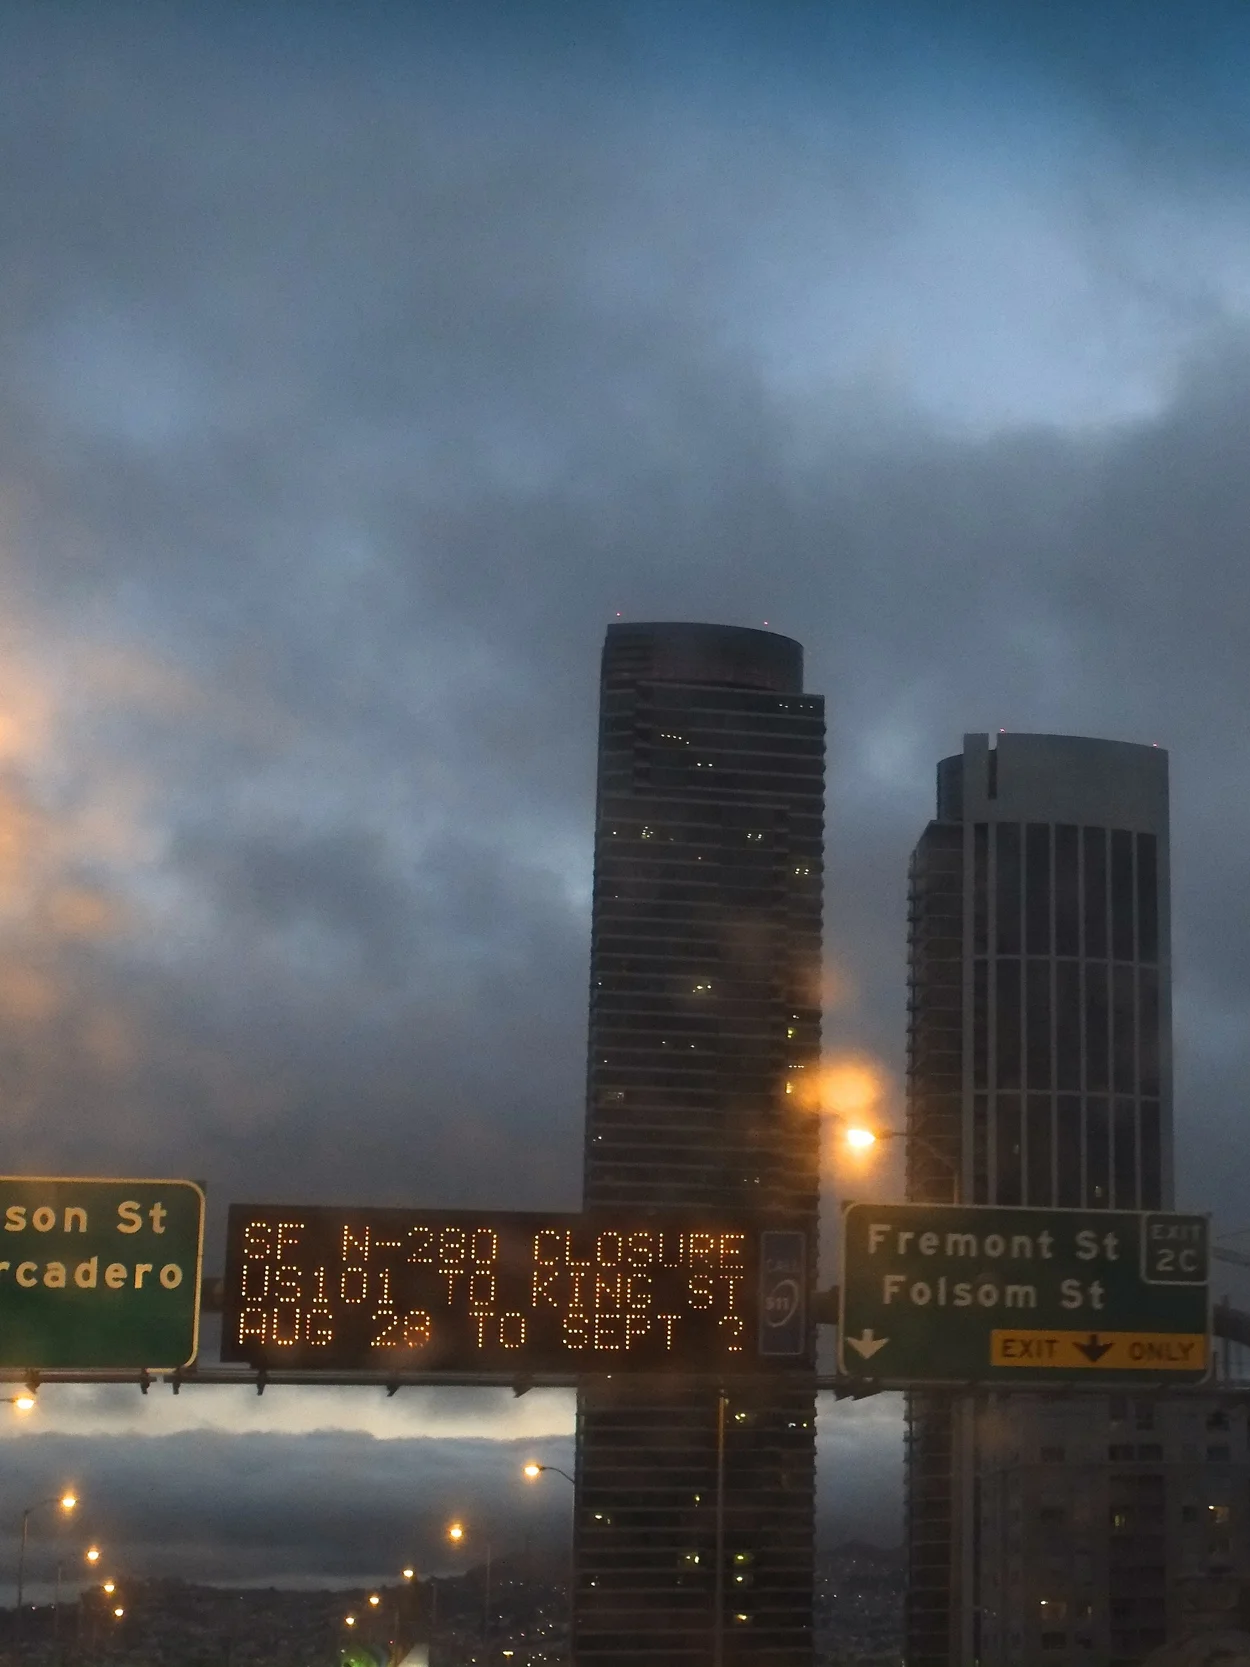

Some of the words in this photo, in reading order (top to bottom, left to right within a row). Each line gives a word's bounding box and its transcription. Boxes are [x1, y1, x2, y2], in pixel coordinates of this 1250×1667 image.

[5, 1204, 88, 1233] son
[117, 1201, 168, 1234] St
[1150, 1223, 1201, 1242] EXIT
[243, 1222, 305, 1260] SF
[342, 1225, 499, 1264] N-280
[534, 1230, 745, 1269] CLOSURE
[867, 1223, 1055, 1259] Fremont
[1075, 1230, 1120, 1261] St
[1155, 1248, 1199, 1273] 2C
[241, 1265, 394, 1304] US101
[438, 1269, 496, 1306] TO
[532, 1271, 652, 1309] KING
[688, 1274, 744, 1309] ST
[882, 1274, 1038, 1309] Folsom
[1060, 1279, 1106, 1310] St
[238, 1308, 334, 1346] AUG
[370, 1310, 431, 1348] 28
[468, 1311, 526, 1349] TO
[562, 1313, 682, 1350] SEPT
[1001, 1338, 1059, 1360] EXIT
[1128, 1341, 1195, 1362] ONLY
